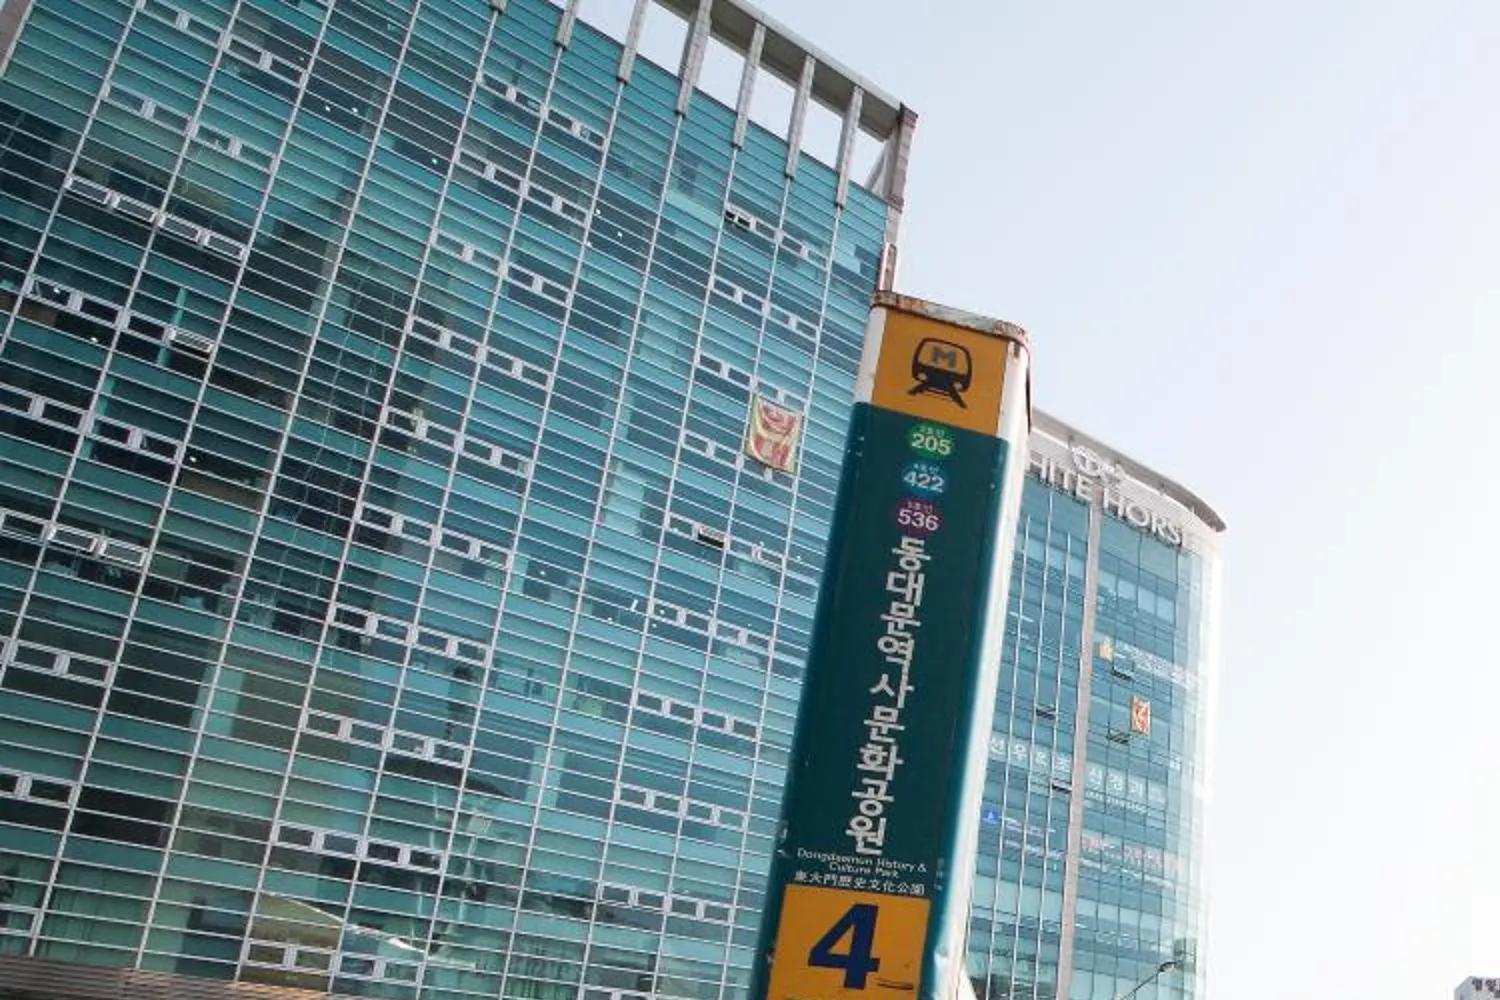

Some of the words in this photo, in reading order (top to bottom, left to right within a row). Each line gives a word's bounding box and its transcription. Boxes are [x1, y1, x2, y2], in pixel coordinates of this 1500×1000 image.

[911, 432, 951, 456] 205
[903, 471, 945, 493] 422
[1026, 451, 1094, 502] HITE
[897, 508, 939, 531] 536
[845, 535, 932, 855] 동대문역사문화공원
[877, 858, 915, 873] History
[807, 902, 881, 991] 4
